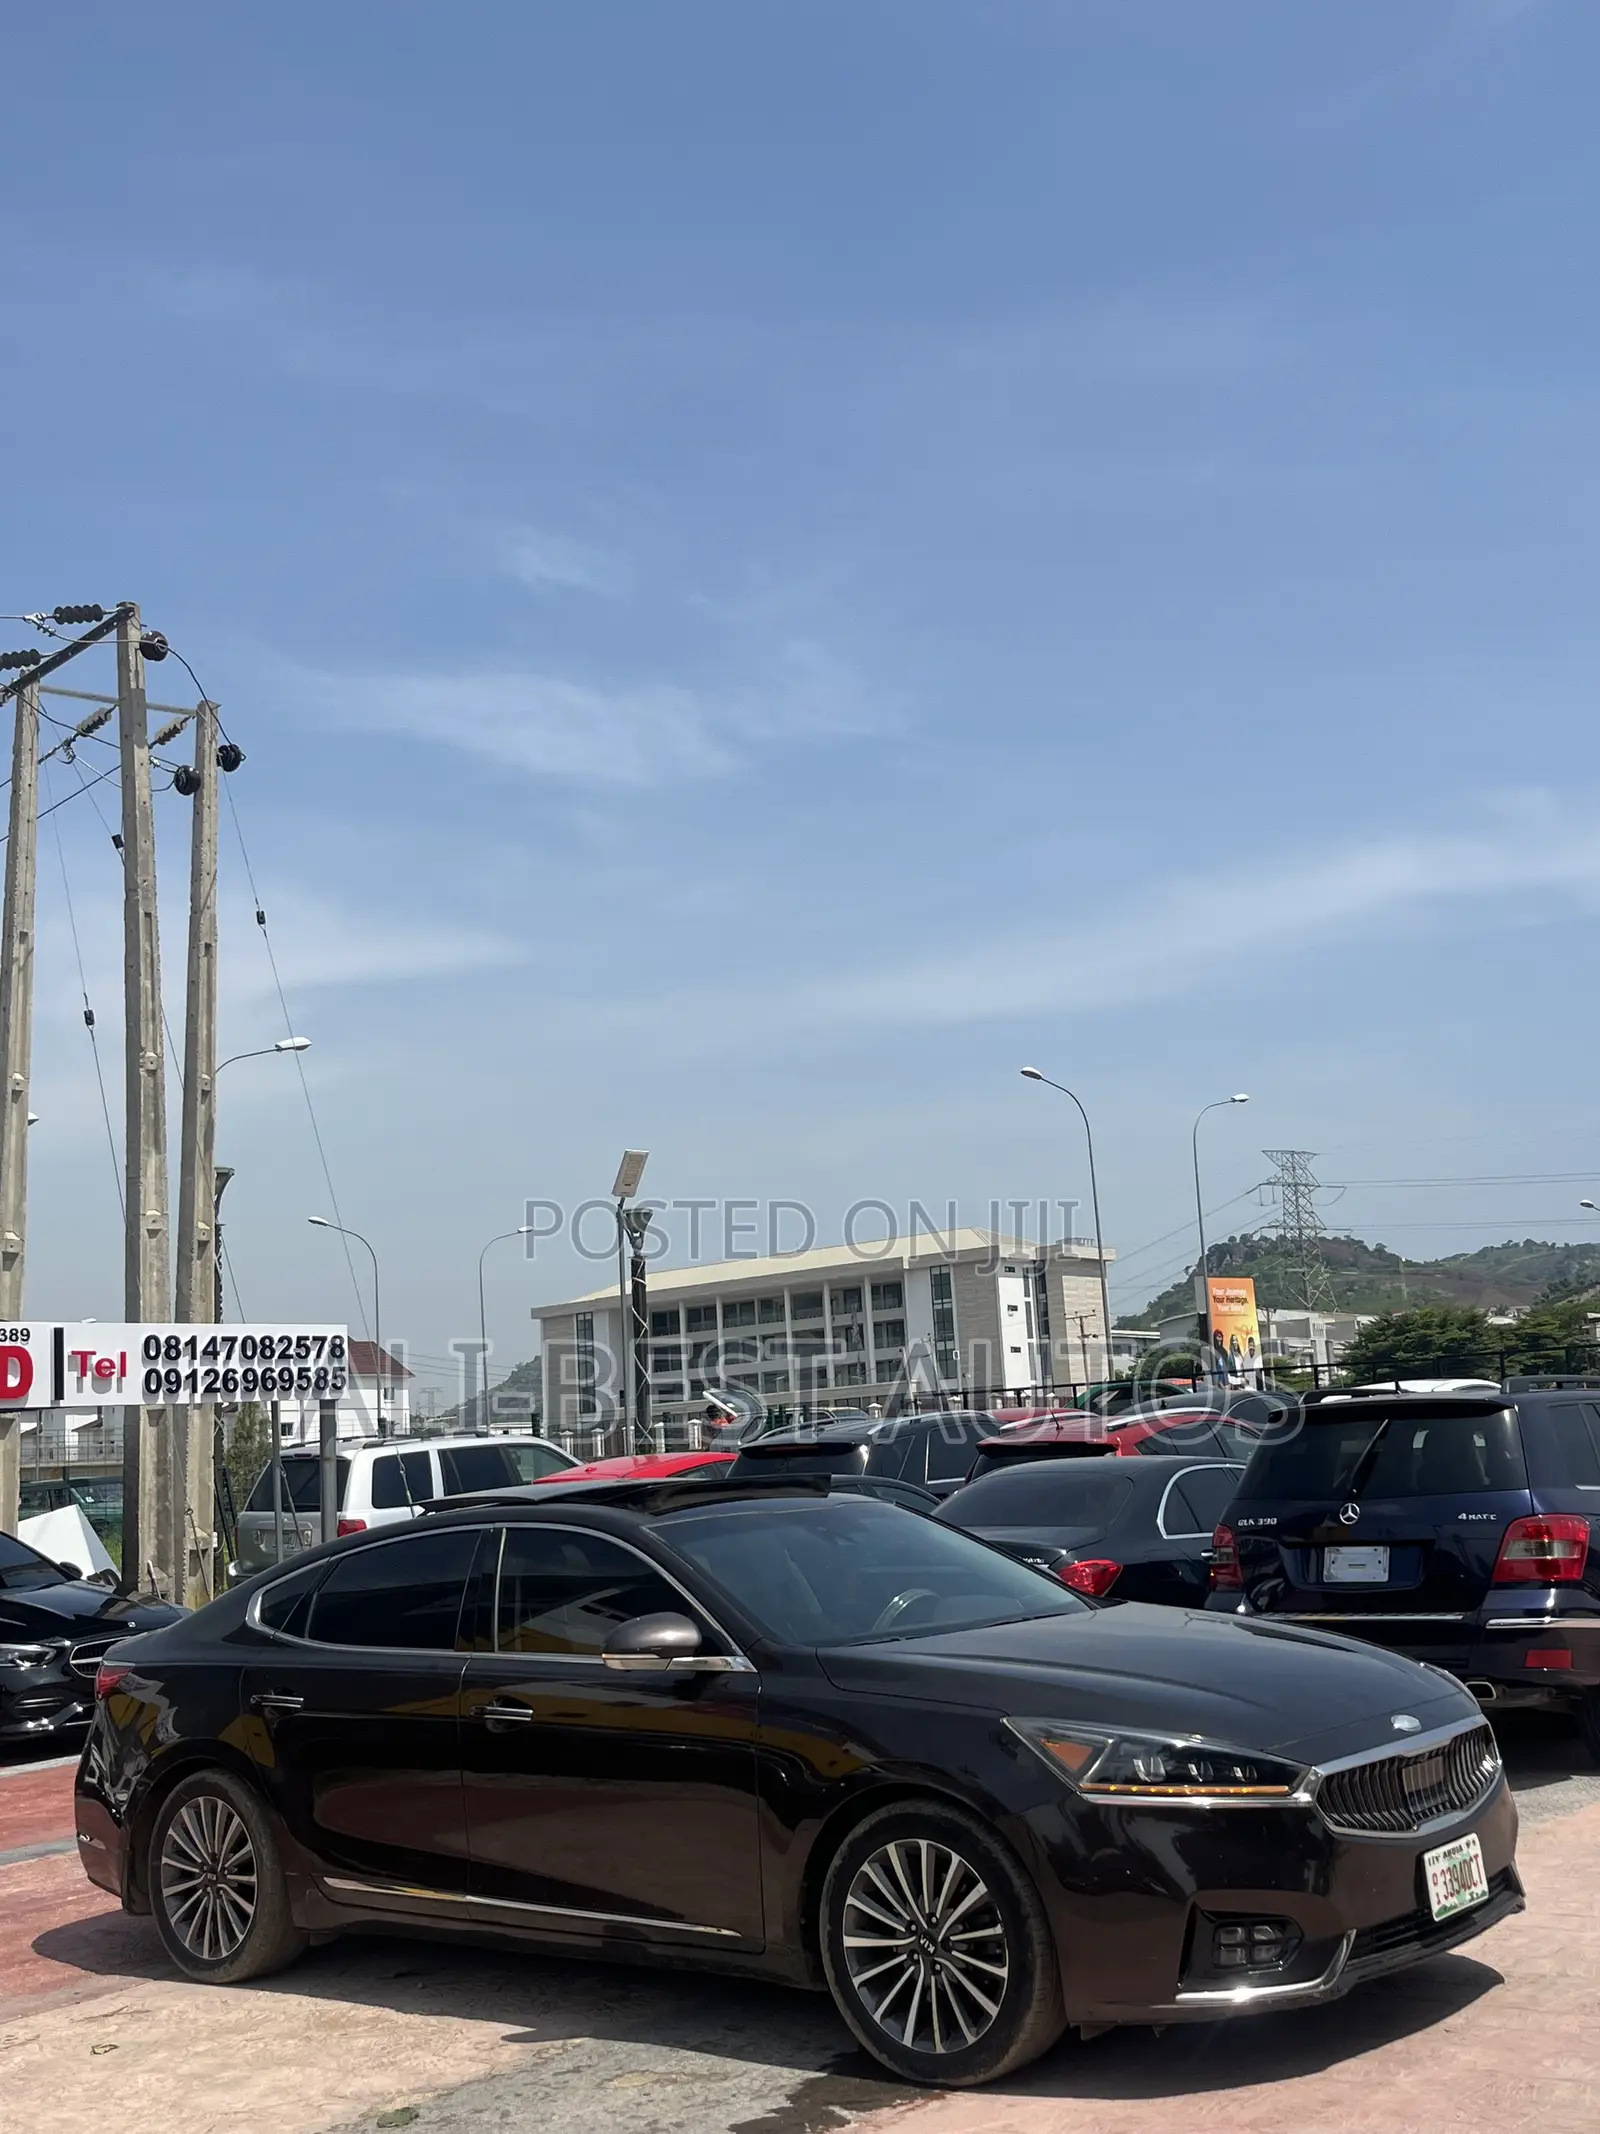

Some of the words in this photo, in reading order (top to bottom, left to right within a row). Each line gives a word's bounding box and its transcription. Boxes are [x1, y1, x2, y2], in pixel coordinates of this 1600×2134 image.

[143, 1335, 346, 1361] 08147082578
[71, 1350, 127, 1378] Tel
[143, 1366, 347, 1395] 09126969585
[920, 1934, 935, 1953] KIA
